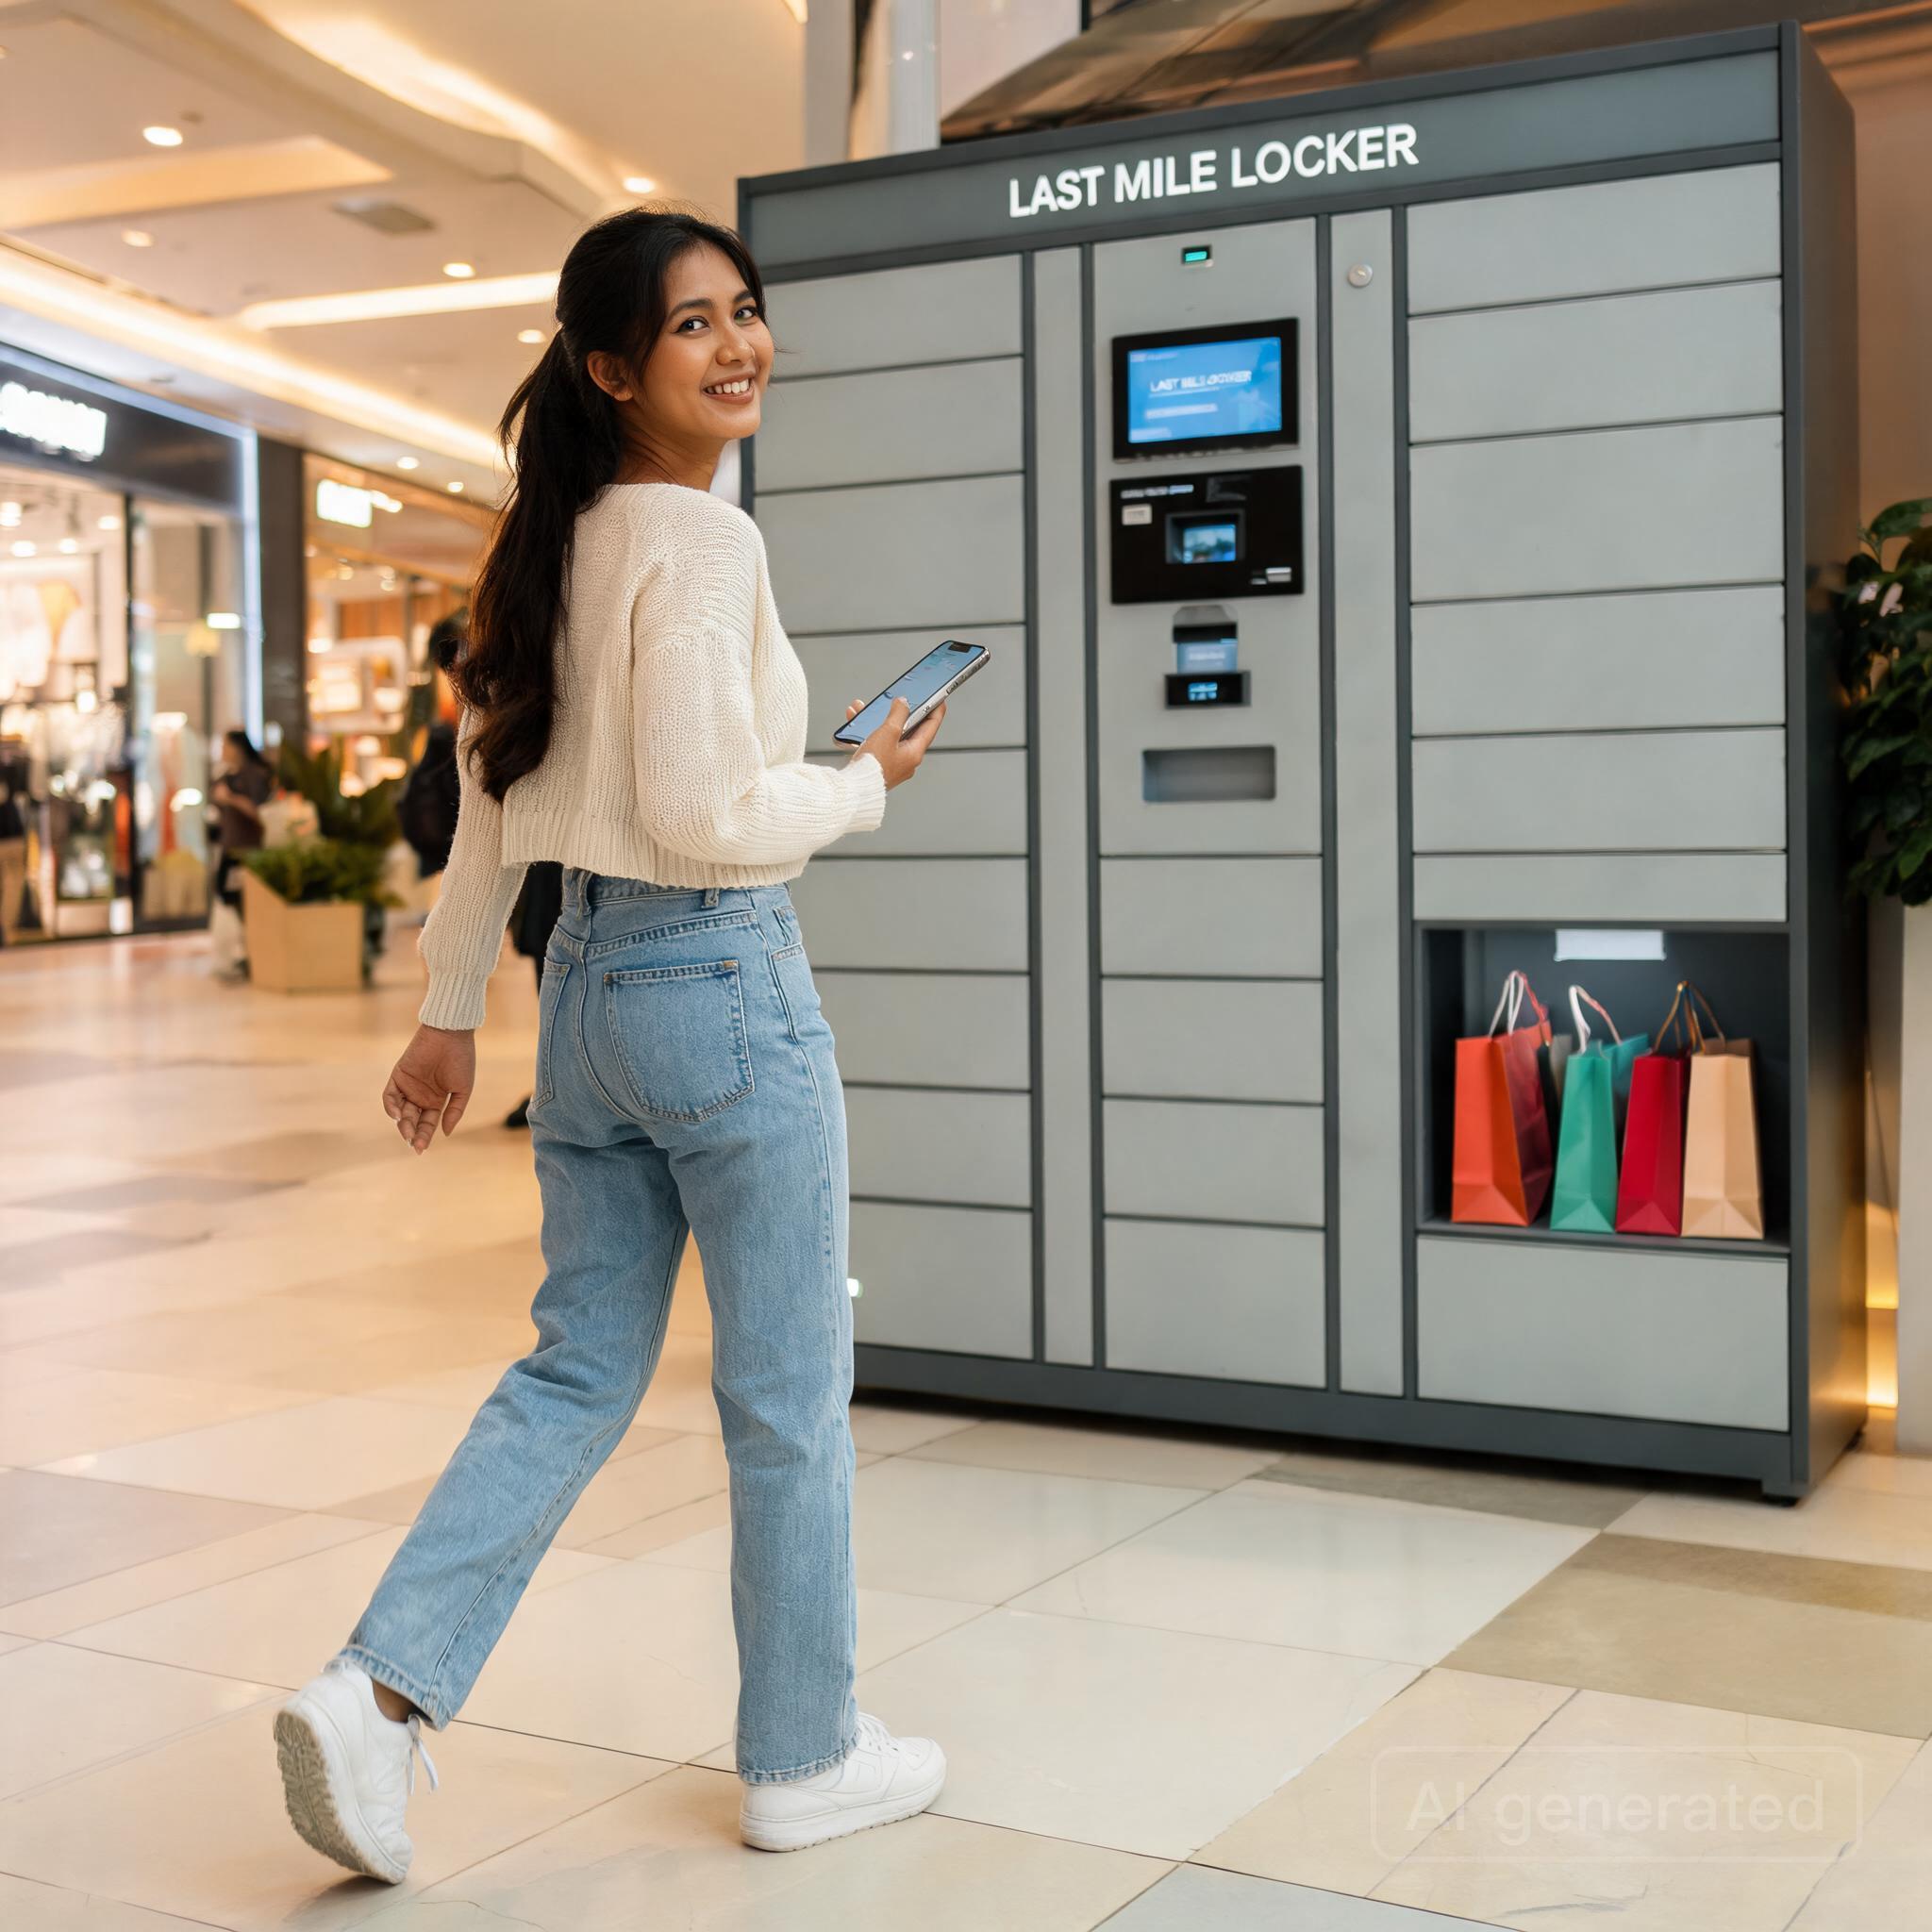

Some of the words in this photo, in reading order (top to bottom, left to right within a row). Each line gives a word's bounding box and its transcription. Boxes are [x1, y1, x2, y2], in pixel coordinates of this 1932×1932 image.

[1008, 165, 1106, 218] LAST
[1114, 150, 1218, 203] MILE
[1231, 124, 1420, 188] LOCKER
